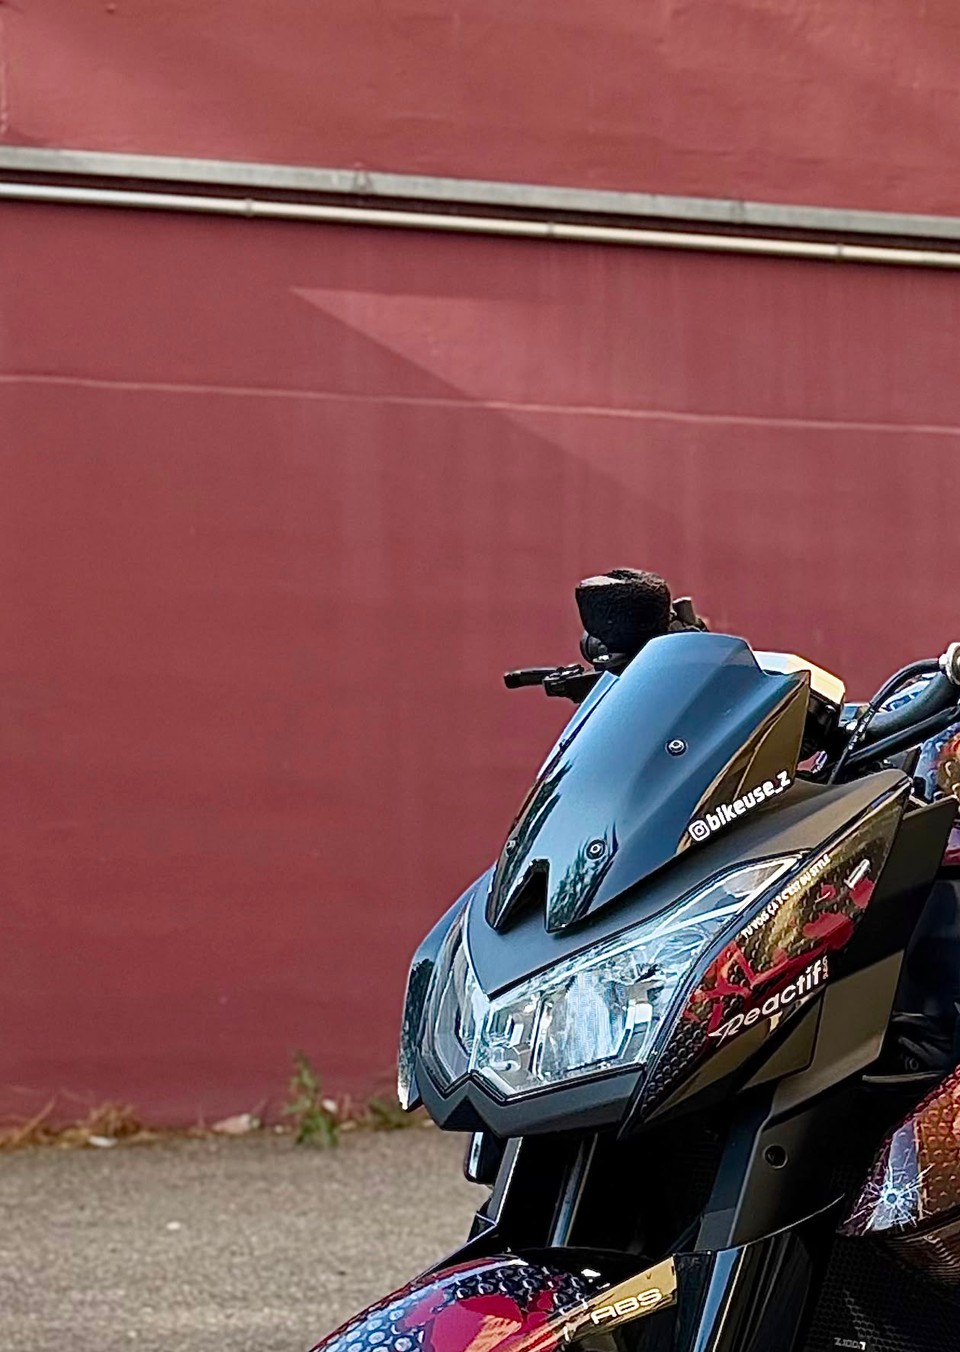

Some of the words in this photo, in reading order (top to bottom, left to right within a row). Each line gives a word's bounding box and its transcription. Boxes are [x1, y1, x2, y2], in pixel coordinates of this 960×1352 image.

[741, 925, 754, 939] TU
[751, 910, 770, 929] VOIS
[708, 959, 821, 1048] Reactif
[590, 1288, 663, 1325] ABS
